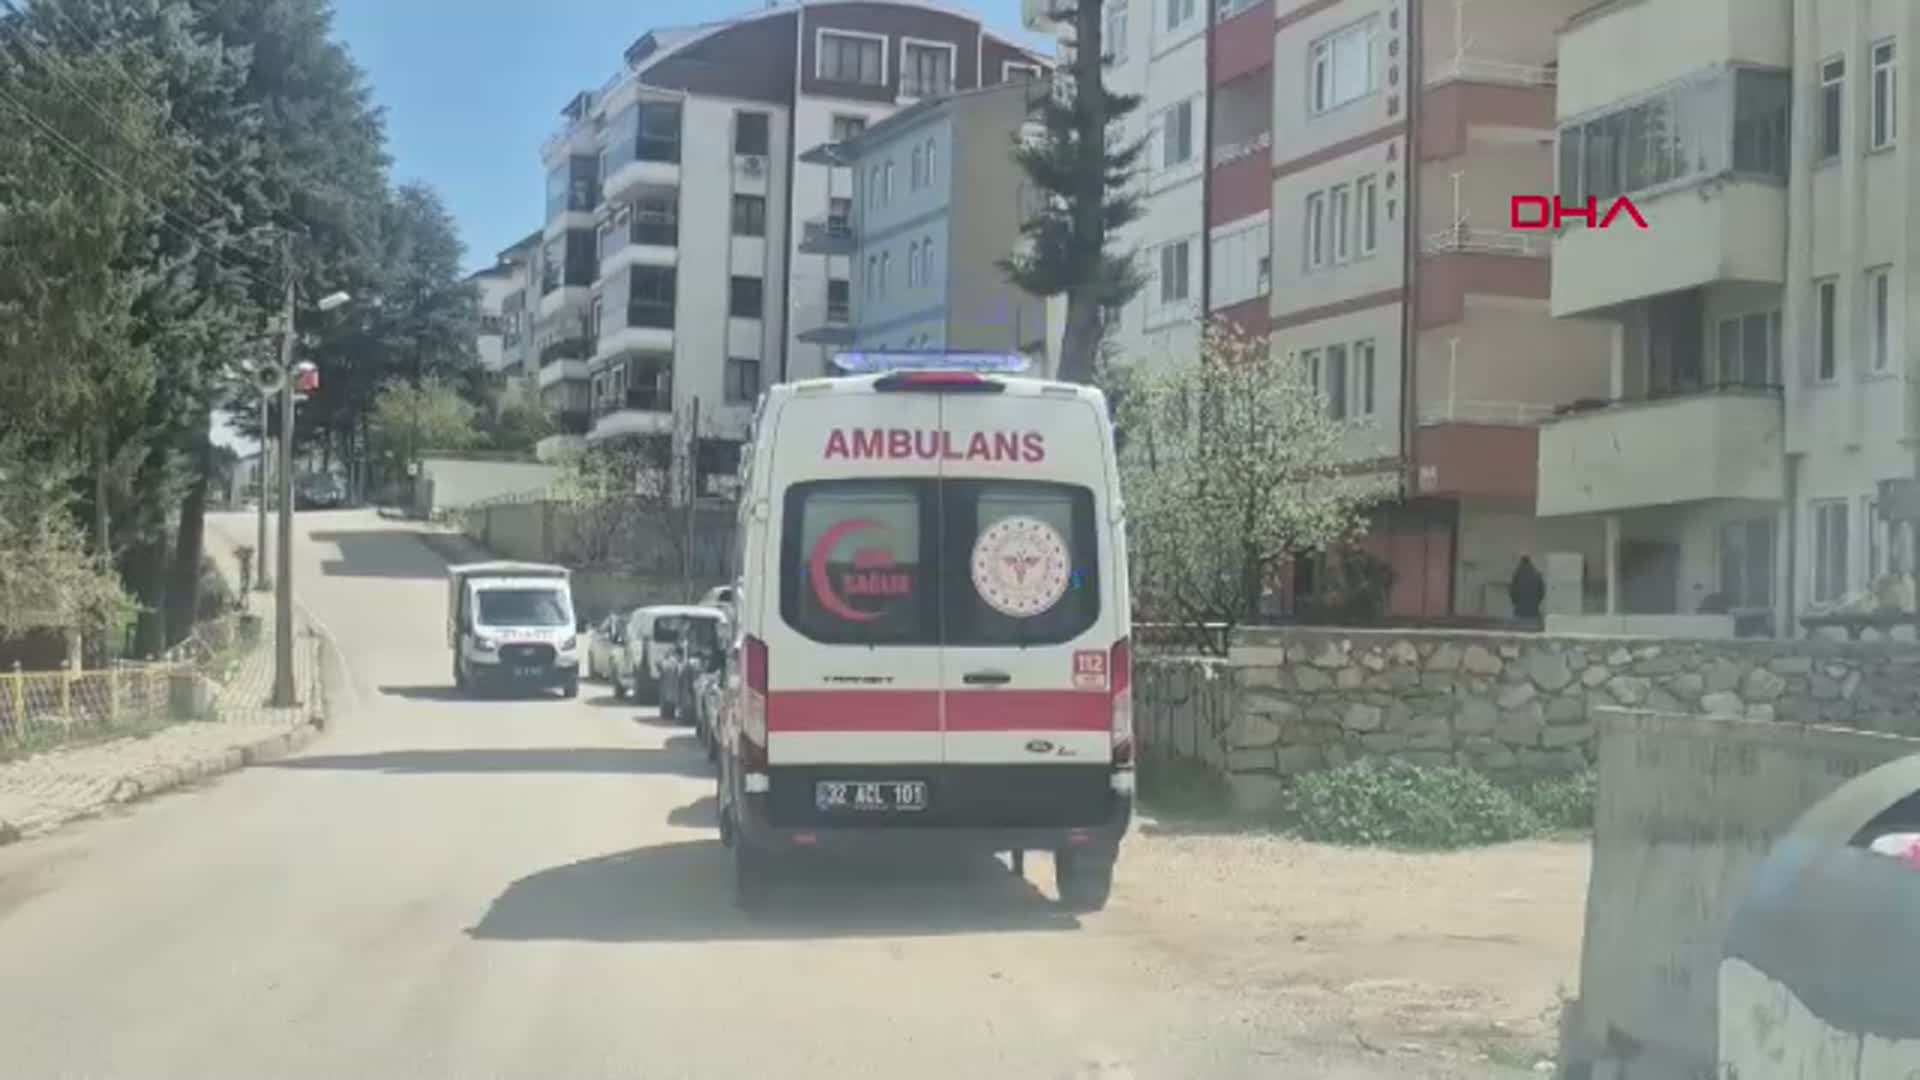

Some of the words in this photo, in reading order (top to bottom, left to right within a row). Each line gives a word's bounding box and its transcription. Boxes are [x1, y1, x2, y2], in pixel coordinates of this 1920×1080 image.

[824, 428, 1046, 463] AMBULANS
[1078, 654, 1104, 671] 112
[894, 783, 922, 804] 101
